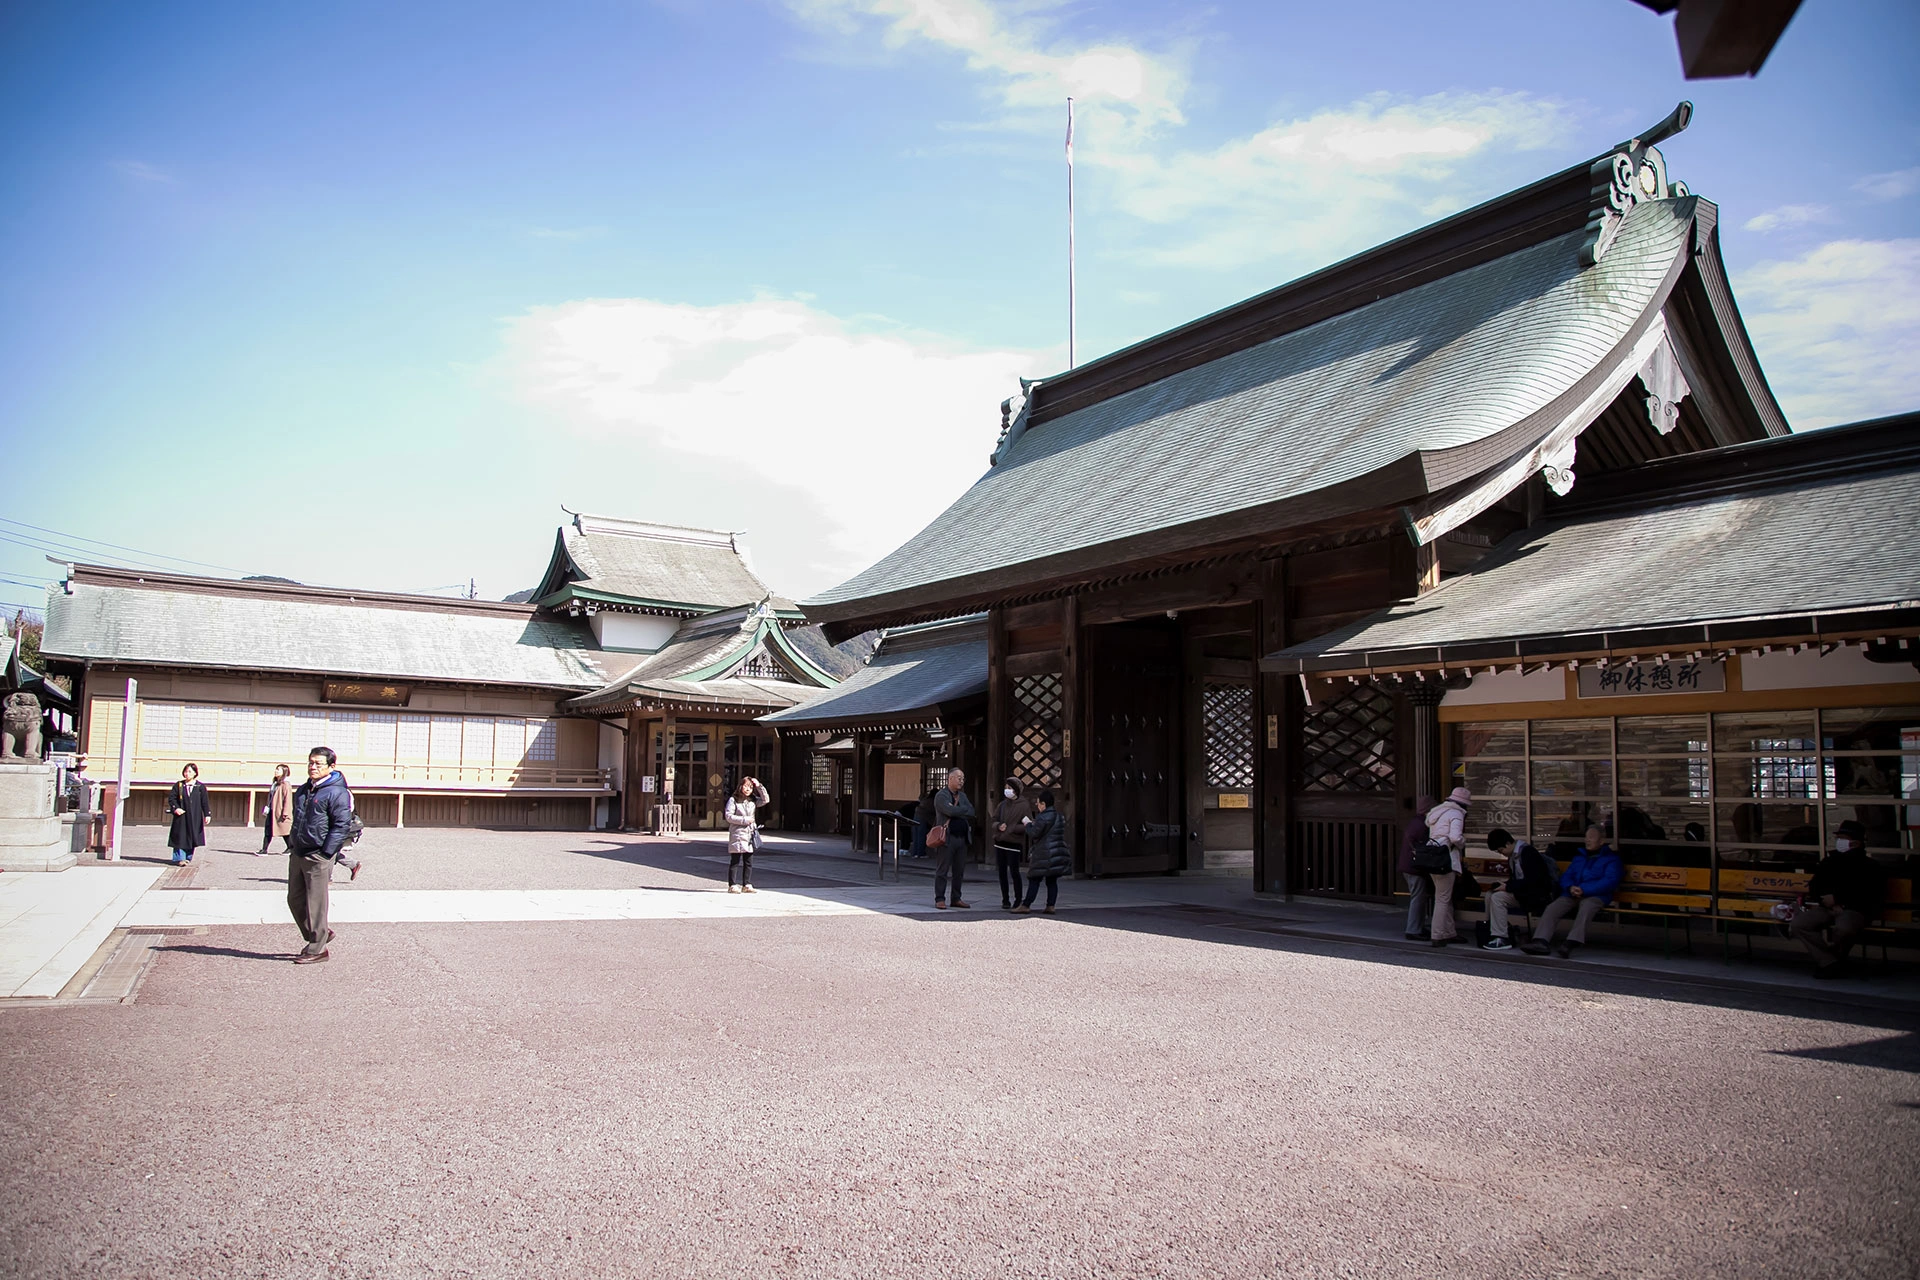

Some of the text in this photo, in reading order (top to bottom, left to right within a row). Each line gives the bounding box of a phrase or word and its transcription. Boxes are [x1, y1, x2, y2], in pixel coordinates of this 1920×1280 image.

[1599, 662, 1701, 692] 御休憩所
[1487, 775, 1515, 787] COFFEE
[1486, 810, 1519, 824] BOSS
